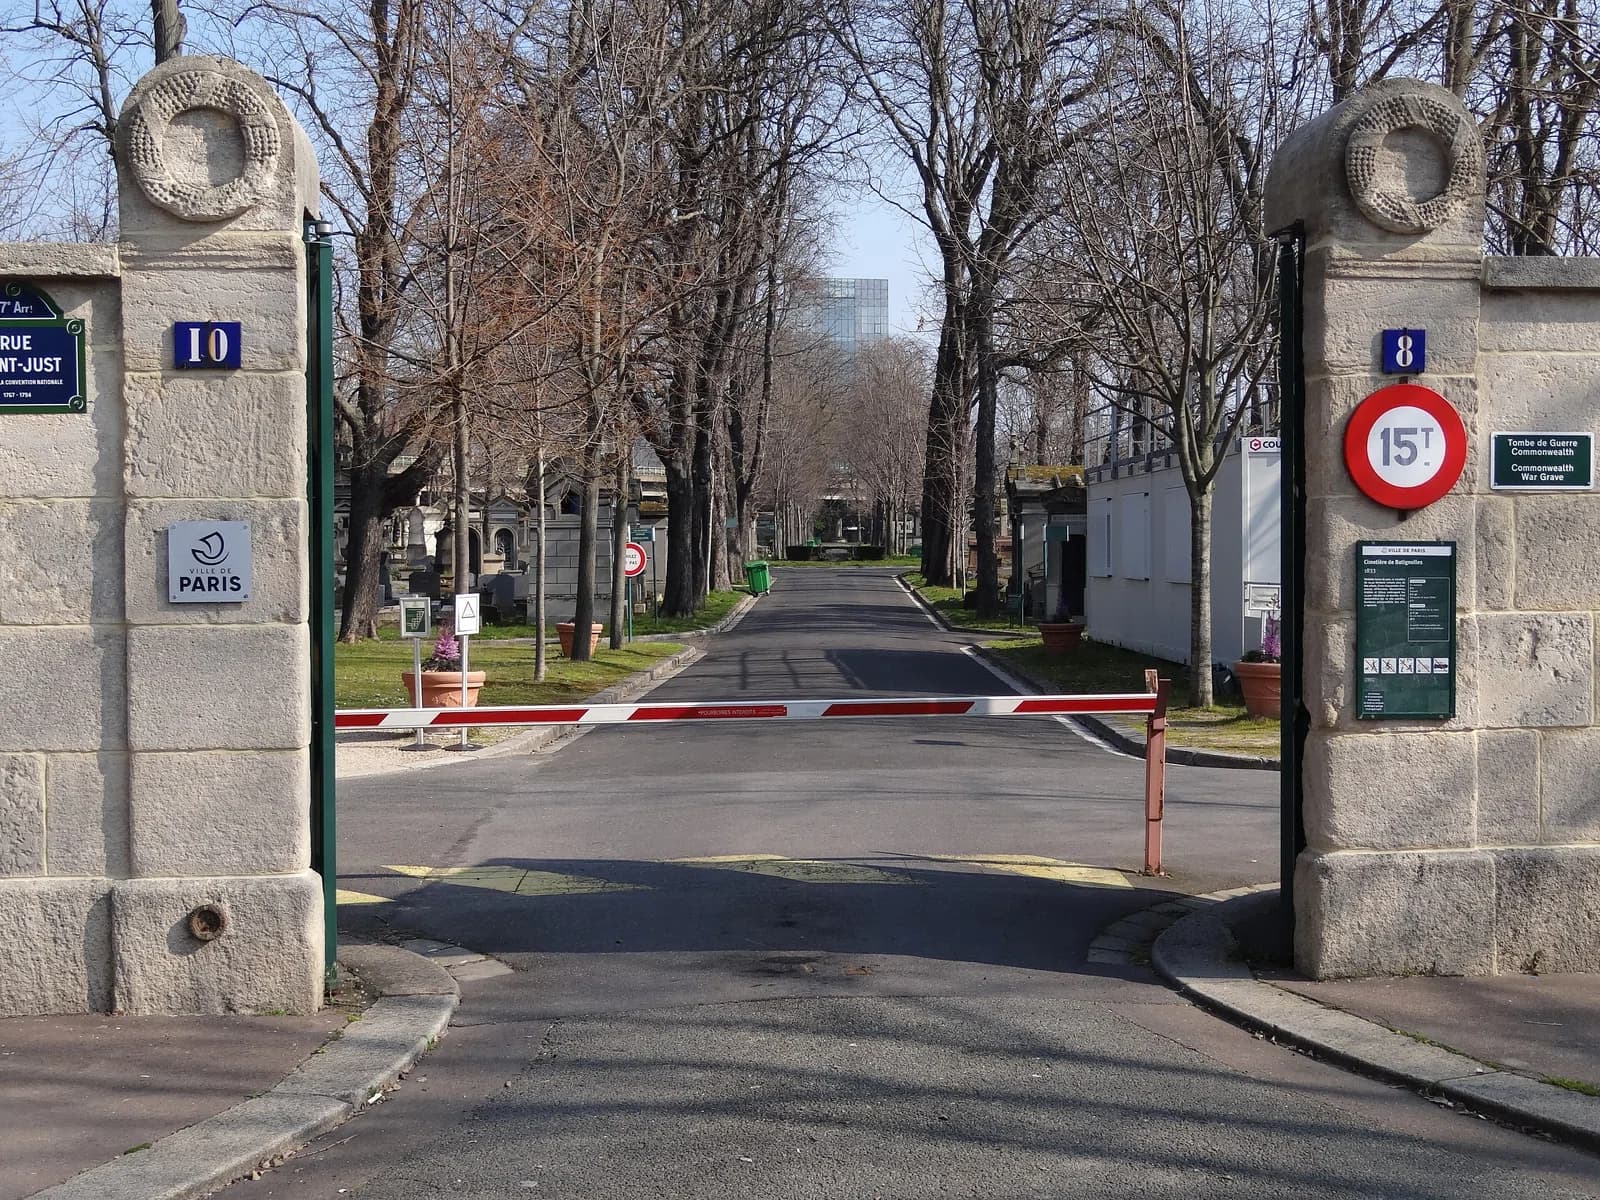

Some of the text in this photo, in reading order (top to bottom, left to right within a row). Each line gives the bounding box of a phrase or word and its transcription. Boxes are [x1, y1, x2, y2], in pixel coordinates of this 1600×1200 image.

[0, 335, 32, 350] RUE
[189, 328, 228, 362] 10
[1396, 335, 1413, 367] 8
[1507, 438, 1578, 447] Tombe de Guerre
[1511, 447, 1574, 456] Commonwealth
[1511, 464, 1574, 472] Commonwealth
[1521, 473, 1564, 481] War Grave
[179, 576, 242, 592] PARIS
